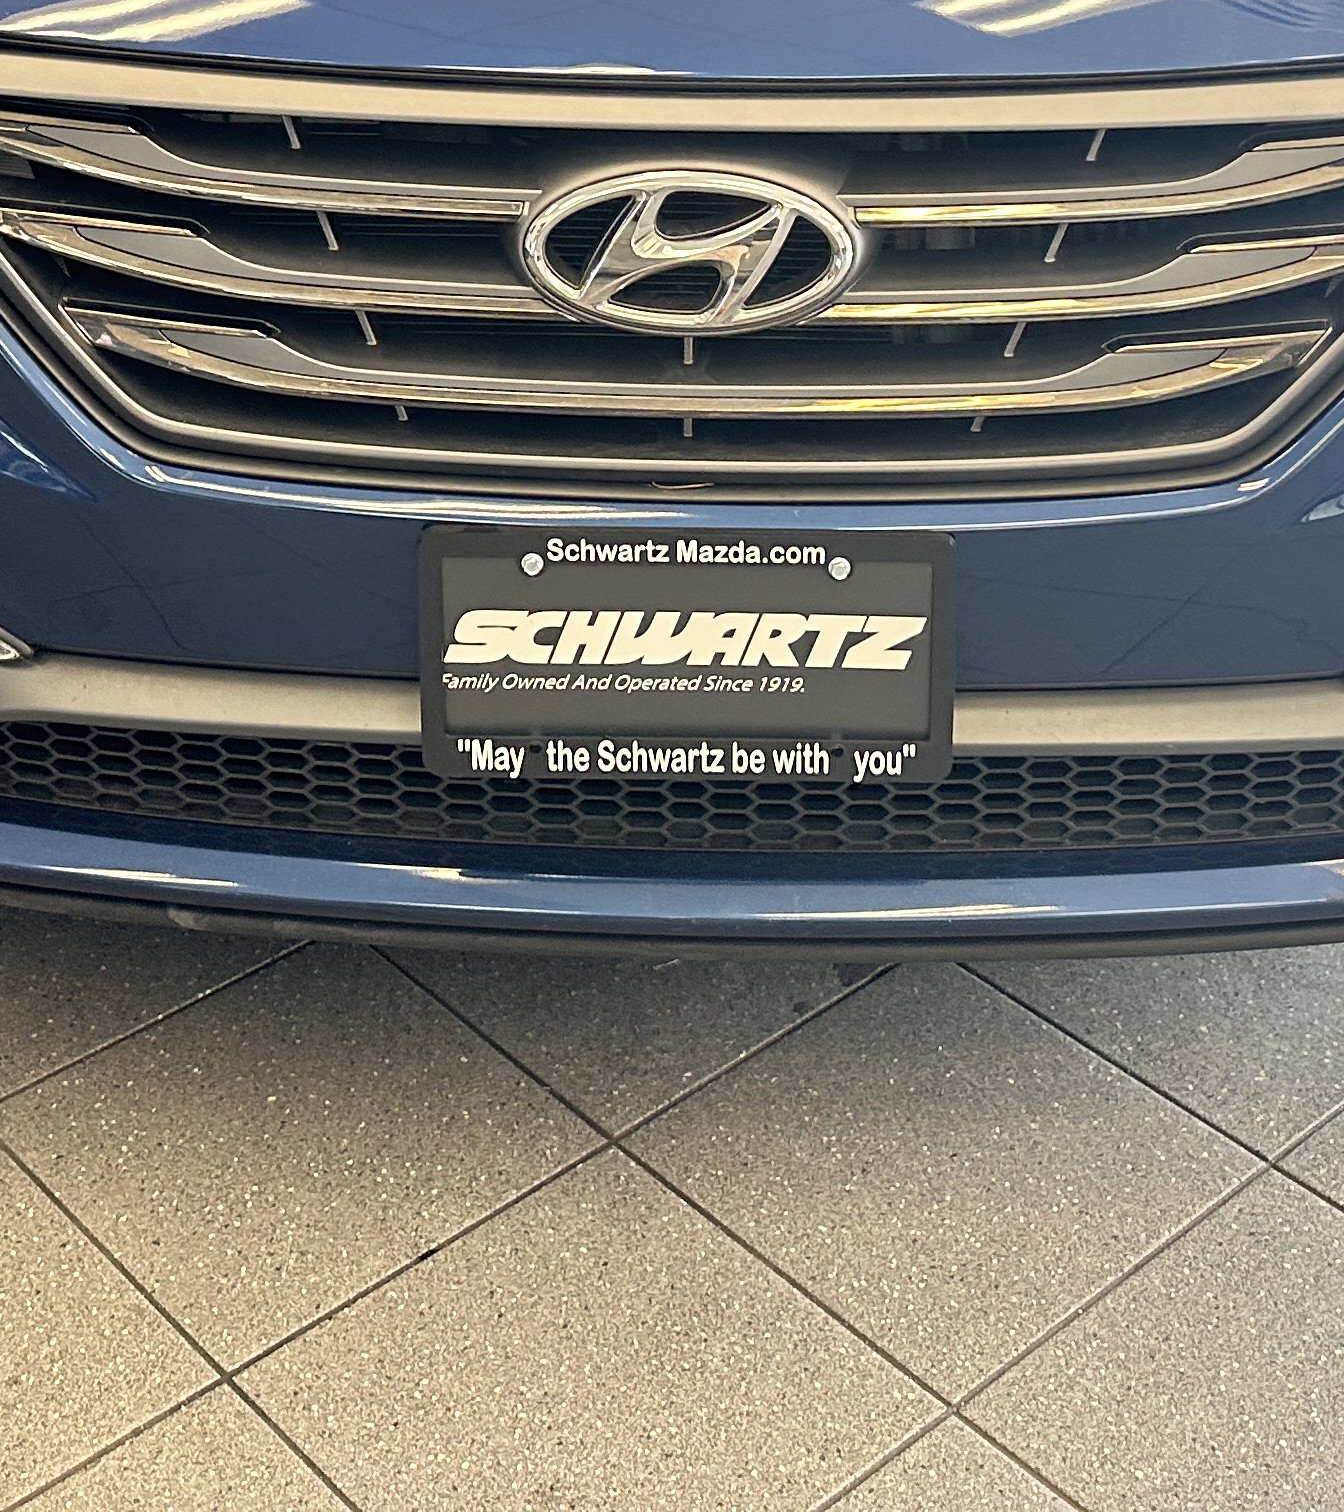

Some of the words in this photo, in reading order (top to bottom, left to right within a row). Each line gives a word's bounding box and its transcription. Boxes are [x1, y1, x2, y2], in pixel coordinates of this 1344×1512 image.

[547, 538, 670, 563] Schwartz
[676, 539, 826, 565] Mazda.com
[442, 609, 928, 671] SCHWARTZ
[502, 673, 570, 690] Owned
[571, 673, 612, 690] And
[614, 674, 702, 694] Operated
[703, 675, 754, 692] Since
[759, 676, 805, 693] 1919.
[457, 738, 525, 779] "May
[546, 739, 590, 772] the
[597, 739, 725, 773] Schwartz
[732, 741, 766, 774] be
[772, 742, 830, 775] with
[853, 743, 916, 783] you"
